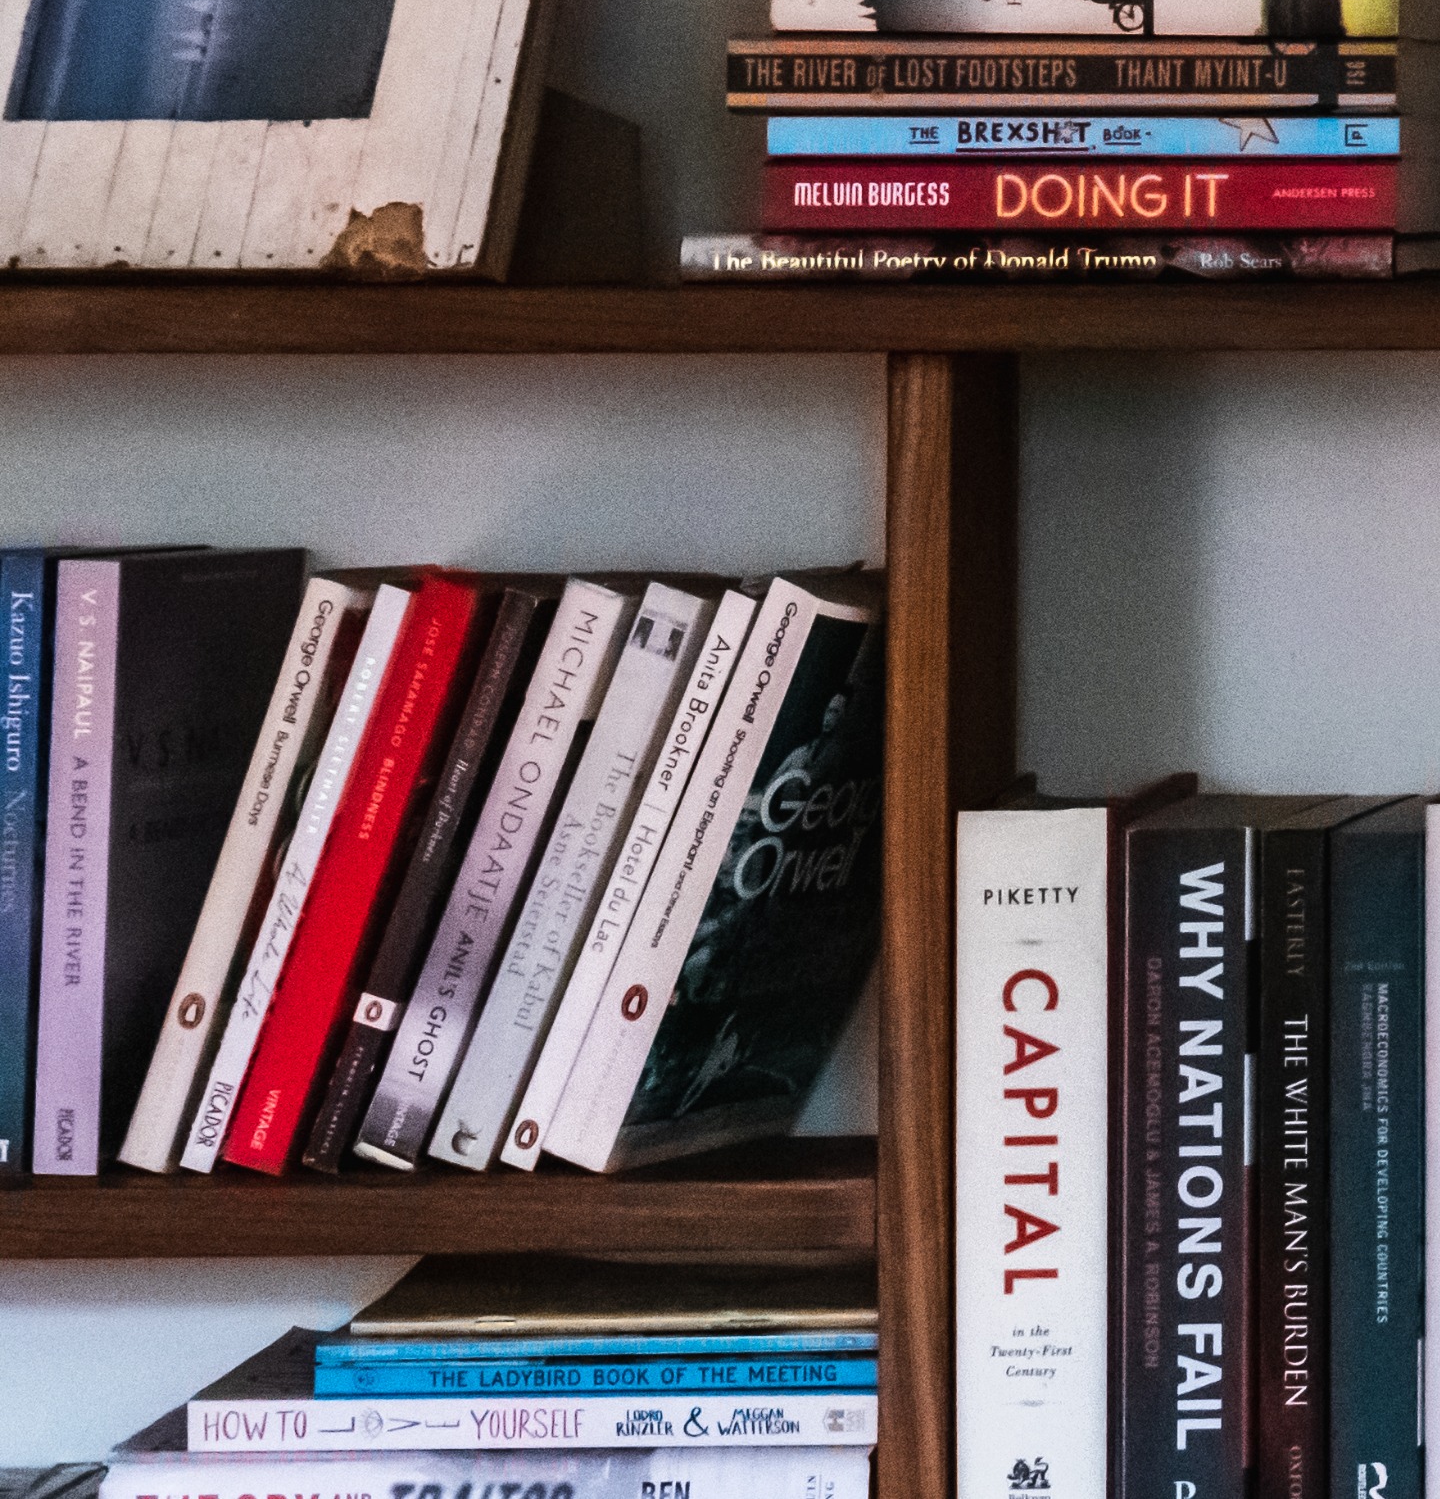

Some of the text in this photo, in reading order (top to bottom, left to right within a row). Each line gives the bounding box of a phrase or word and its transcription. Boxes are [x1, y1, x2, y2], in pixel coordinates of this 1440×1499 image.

[744, 58, 1078, 89] THE RIVER LOST FOOTSTEPS
[1114, 58, 1288, 89] THANT MYINT-U
[908, 125, 940, 141] THE
[1102, 125, 1142, 142] BOOK
[794, 182, 950, 207] MELVIN BURGESS
[996, 174, 1230, 218] DOING IT
[1271, 188, 1376, 199] ANDERSEN PRESS
[712, 249, 753, 271] The
[761, 247, 864, 272] Beautiful
[872, 250, 946, 271] Poetry
[953, 247, 982, 270] of
[983, 247, 1069, 271] Donald
[1200, 251, 1282, 270] Rob Sears
[1, 590, 35, 773] Kazuo Ishiguro
[247, 598, 335, 827] George Orwell Burmese Days
[357, 661, 429, 841] SARAMAGO BLINDNESS
[683, 600, 799, 871] George Orwell Shooting Elephant
[591, 633, 732, 955] Anita Brookner Hotel du Lac
[64, 640, 96, 988] NAIPAUL BEND IN THE RIVER
[406, 609, 600, 1083] MICHAEL ONDAATJE ANIL'S GHOST
[513, 750, 638, 1033] The Bookseller Kabul
[983, 886, 1080, 906] PIKETTY
[195, 1080, 235, 1148] PICADOR
[250, 1089, 282, 1152] VINTAGE
[1002, 967, 1062, 1296] CAPITAL
[55, 1106, 75, 1162] PICADOR
[1283, 868, 1309, 1407] EASTERLY THE WHITE MAN'S BURDEN
[1376, 982, 1390, 1325] MACROECONOMICS FOR DEVELOPING COUNTRIES
[1144, 956, 1162, 1369] DARON ACEMOGLU JAMES ROBINSON
[1176, 860, 1225, 1451] WHY NATIONS FAIL
[1030, 1324, 1050, 1337] the
[990, 1344, 1073, 1360] Twenty-First
[430, 1364, 838, 1388] THE LADYBIRD BOOK OF THE MEETING
[1005, 1364, 1057, 1380] Century
[203, 1407, 585, 1442] HOW TO YOURSELF
[615, 1420, 675, 1437] RINZLER
[683, 1406, 710, 1438] &
[717, 1419, 801, 1438] WATTERSON
[731, 1407, 785, 1422] MEGGAN
